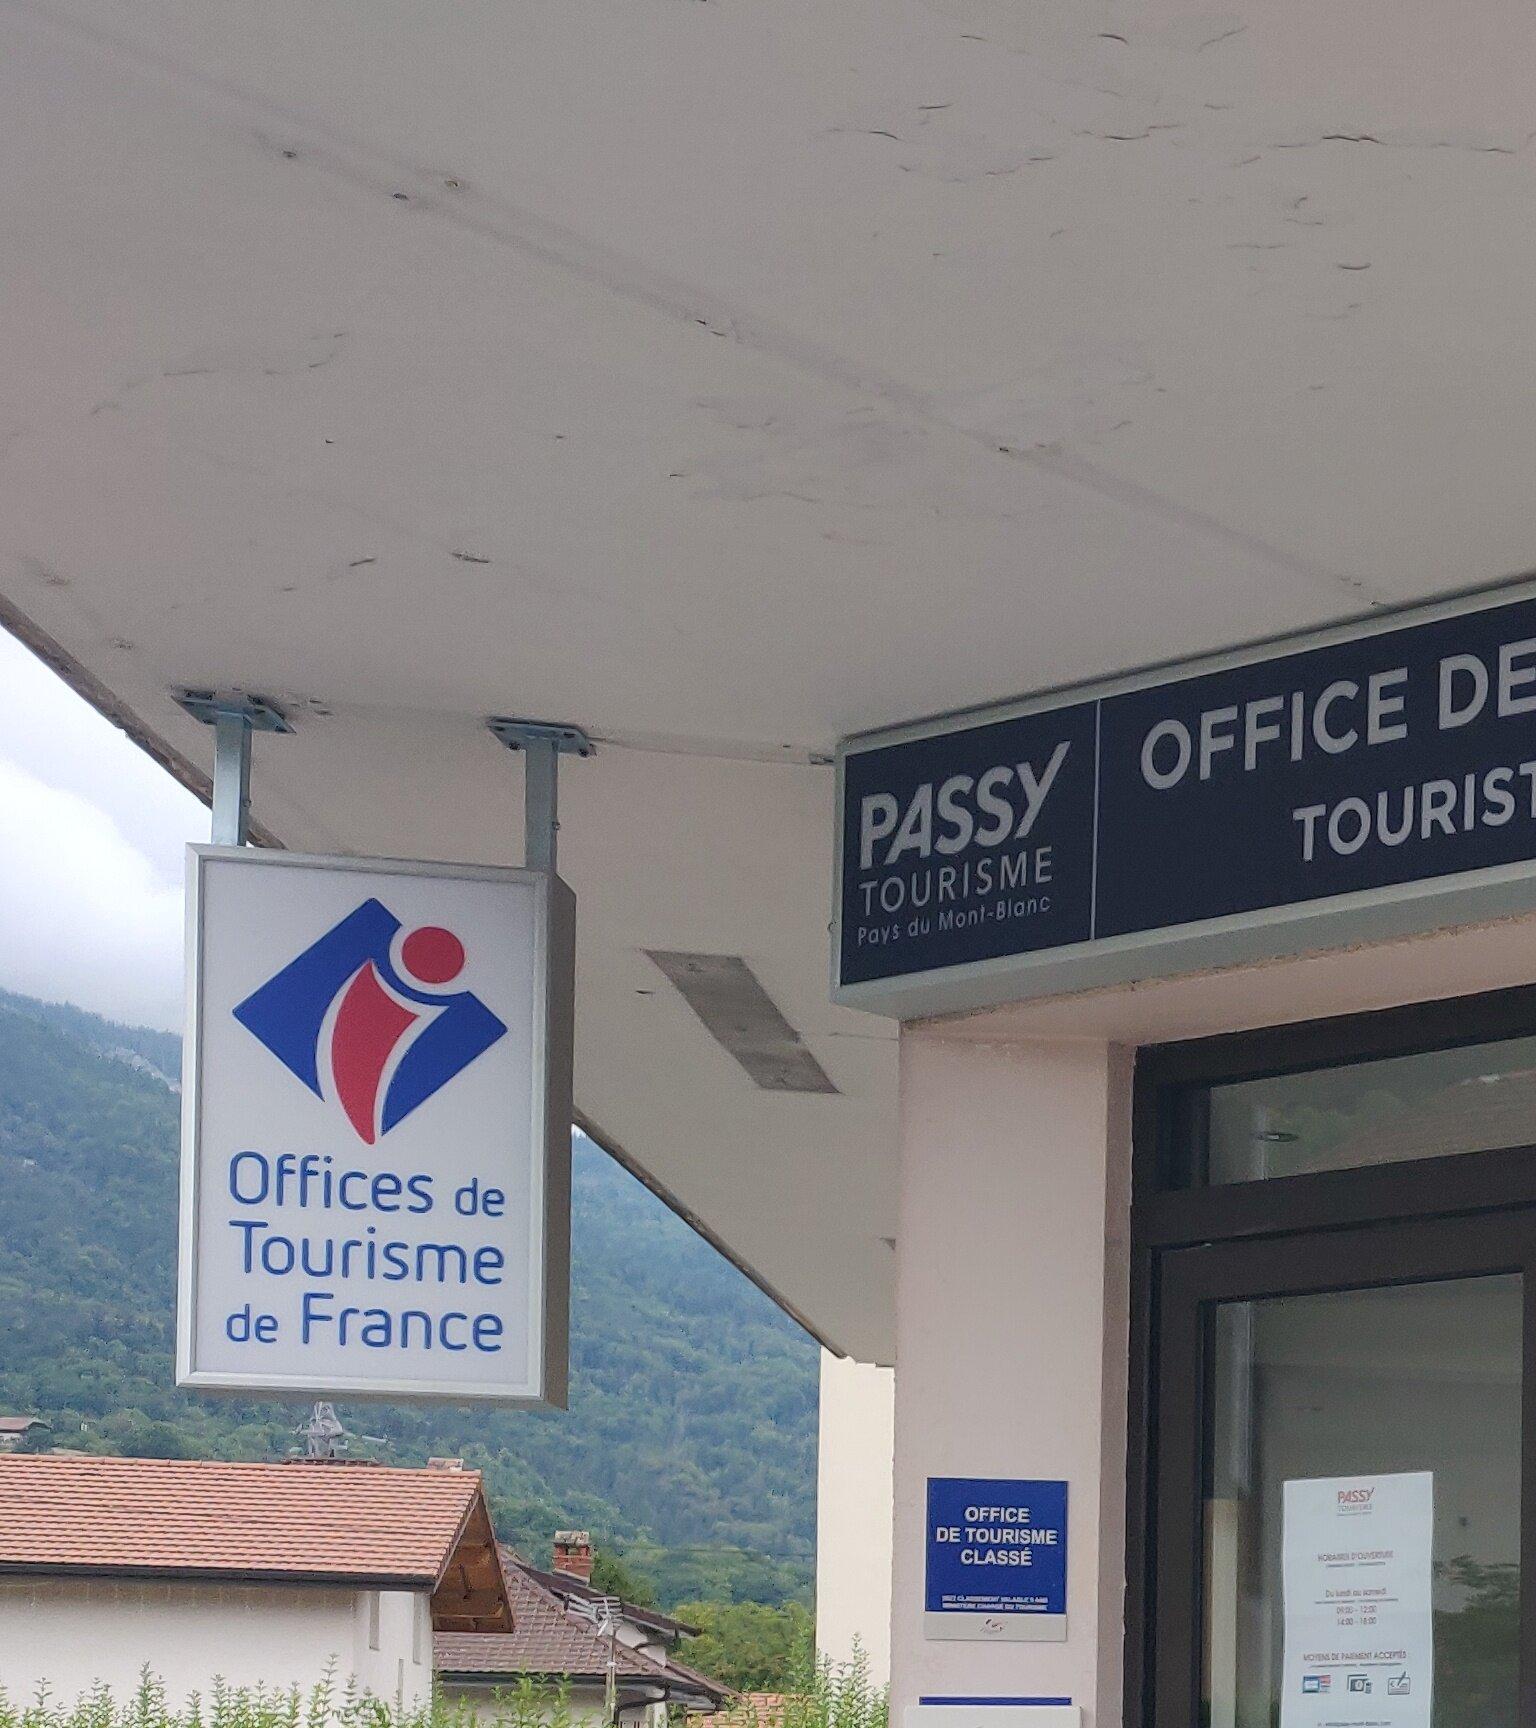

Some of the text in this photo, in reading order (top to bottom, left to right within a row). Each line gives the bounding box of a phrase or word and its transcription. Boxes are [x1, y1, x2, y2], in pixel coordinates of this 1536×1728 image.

[1139, 664, 1410, 793] OFFICE
[859, 740, 1072, 871] PASSY
[858, 845, 1053, 917] TOURISME
[858, 895, 1051, 946] Pays du Mont-Blanc
[229, 1150, 505, 1218] Offices de
[228, 1220, 505, 1285] Tourisme
[225, 1293, 503, 1353] de France
[935, 1526, 1058, 1546] DE TOURISME
[963, 1505, 1031, 1524] OFFICE
[960, 1547, 1033, 1567] CLASSÉ
